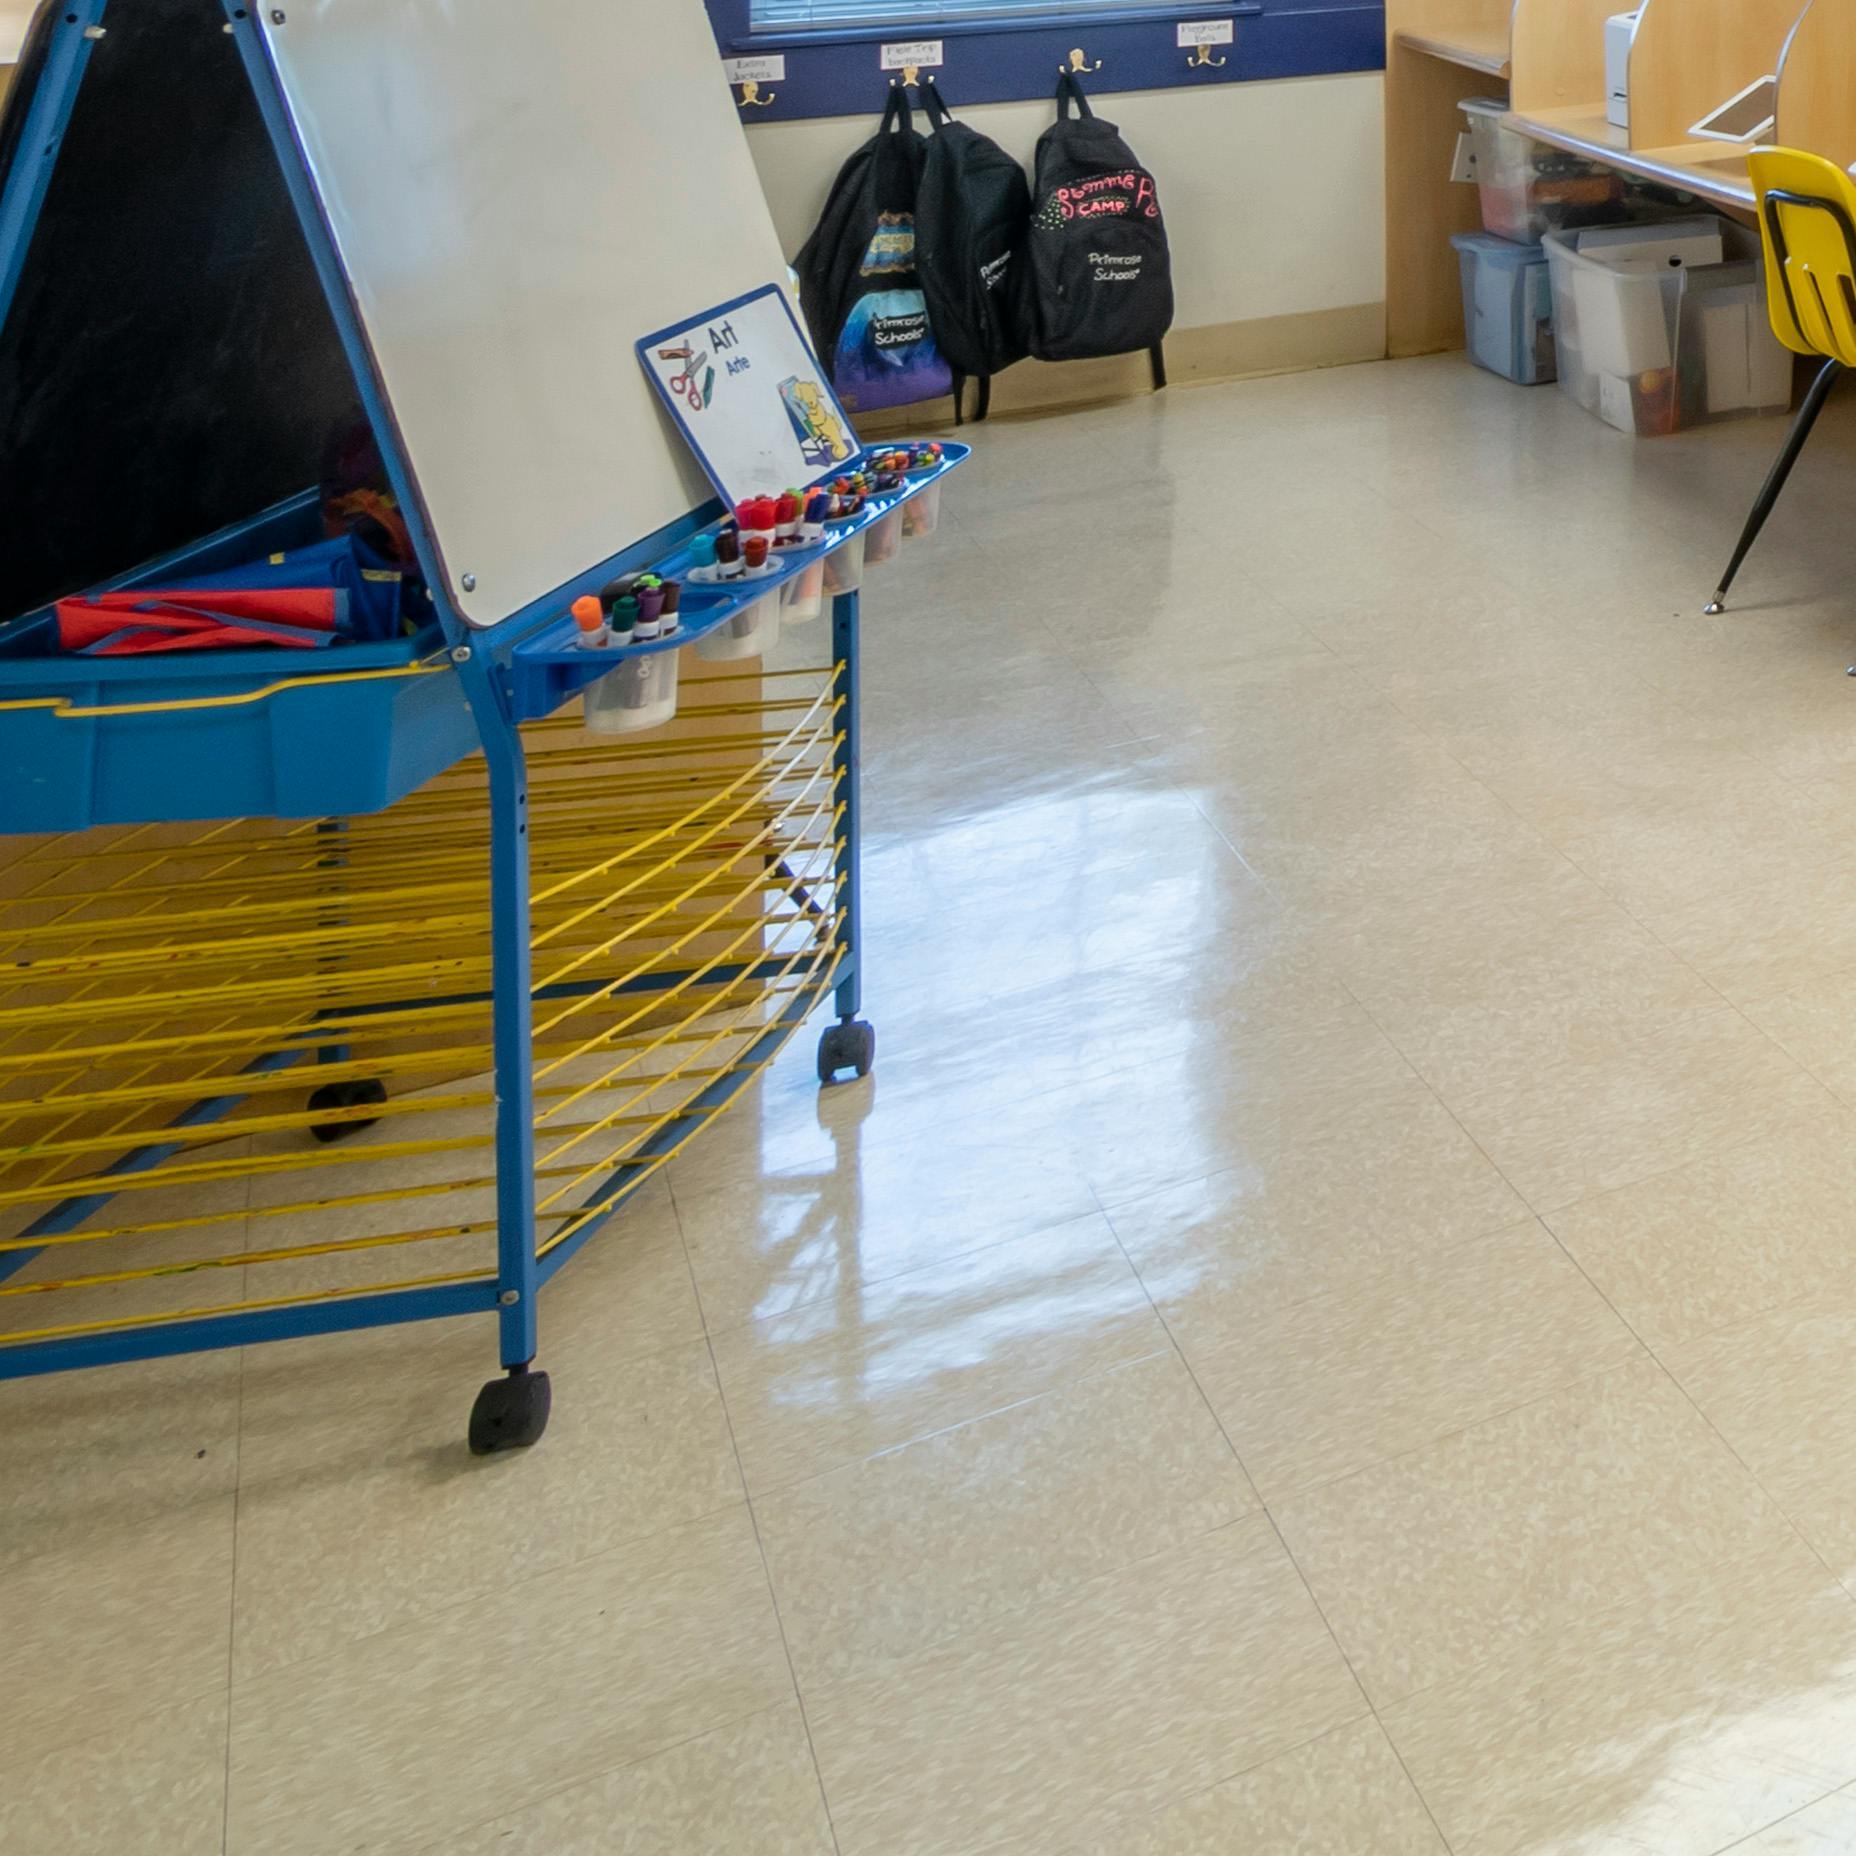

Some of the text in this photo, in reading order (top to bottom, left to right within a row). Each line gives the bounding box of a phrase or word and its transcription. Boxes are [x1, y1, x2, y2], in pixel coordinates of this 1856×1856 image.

[1079, 200, 1126, 217] CAMP
[1088, 252, 1142, 265] Primrose
[708, 321, 739, 354] Art
[725, 356, 750, 376] Arte
